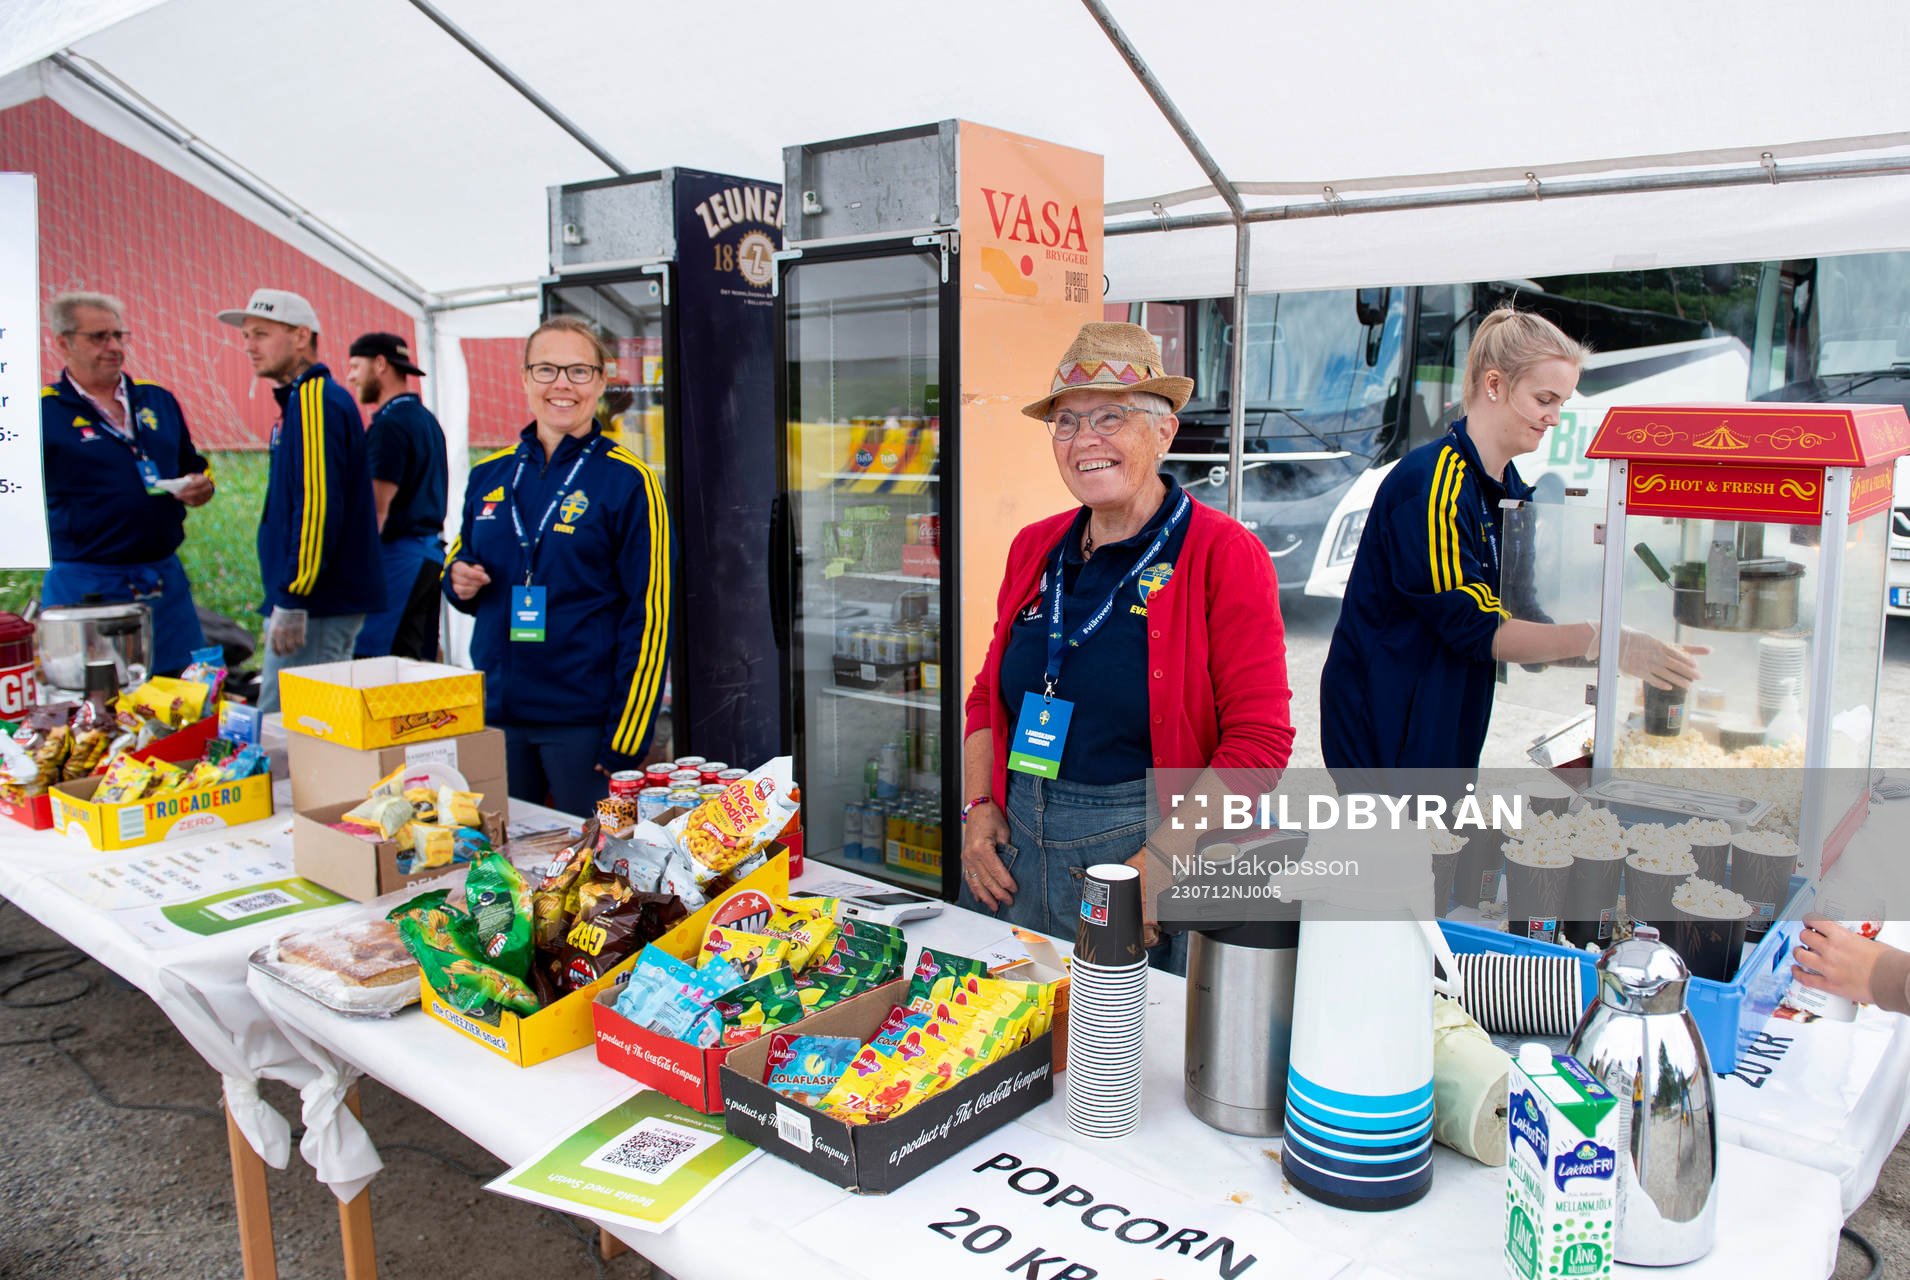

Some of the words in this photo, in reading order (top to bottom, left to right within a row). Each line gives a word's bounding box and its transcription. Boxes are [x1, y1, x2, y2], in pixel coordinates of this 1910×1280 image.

[981, 188, 1088, 252] VASA
[714, 242, 734, 272] 18
[1046, 249, 1088, 265] BRYGGERI
[1065, 271, 1089, 289] DUBBELT
[1065, 287, 1072, 301] SÅ
[1670, 479, 1701, 492] HOT
[1706, 480, 1718, 493] &
[1722, 481, 1775, 495] FRESH
[146, 786, 242, 820] TROCADERO
[728, 781, 760, 824] cheez
[178, 815, 215, 831] ZERO
[432, 1002, 446, 1018] the
[445, 1010, 482, 1037] CHEEZIER
[483, 1030, 508, 1052] snack
[601, 1031, 625, 1050] product
[624, 1043, 632, 1056] of
[632, 1043, 644, 1059] The
[672, 1062, 702, 1088] Company
[774, 1051, 796, 1061] Malaco
[859, 1057, 880, 1073] Malaco
[725, 1097, 731, 1106] a
[730, 1098, 758, 1119] product
[757, 1112, 767, 1126] of
[767, 1112, 780, 1129] Th
[889, 1149, 898, 1164] a
[896, 1124, 940, 1167] product
[939, 1114, 953, 1139] of
[952, 1098, 974, 1128] The
[1012, 1062, 1050, 1094] Company
[1510, 1109, 1549, 1155] LaktosFRI
[814, 1136, 851, 1166] Company
[1558, 1157, 1614, 1177] LaktosFRI
[547, 1173, 581, 1189] Swish
[580, 1182, 610, 1198] med
[613, 1186, 656, 1208] Betala
[1555, 1198, 1613, 1212] MELLANMJÖLK
[972, 1152, 1258, 1280] POPCORN
[928, 1207, 1012, 1254] 20
[1512, 1213, 1534, 1259] LÅNG
[1569, 1243, 1597, 1264] LÅNG
